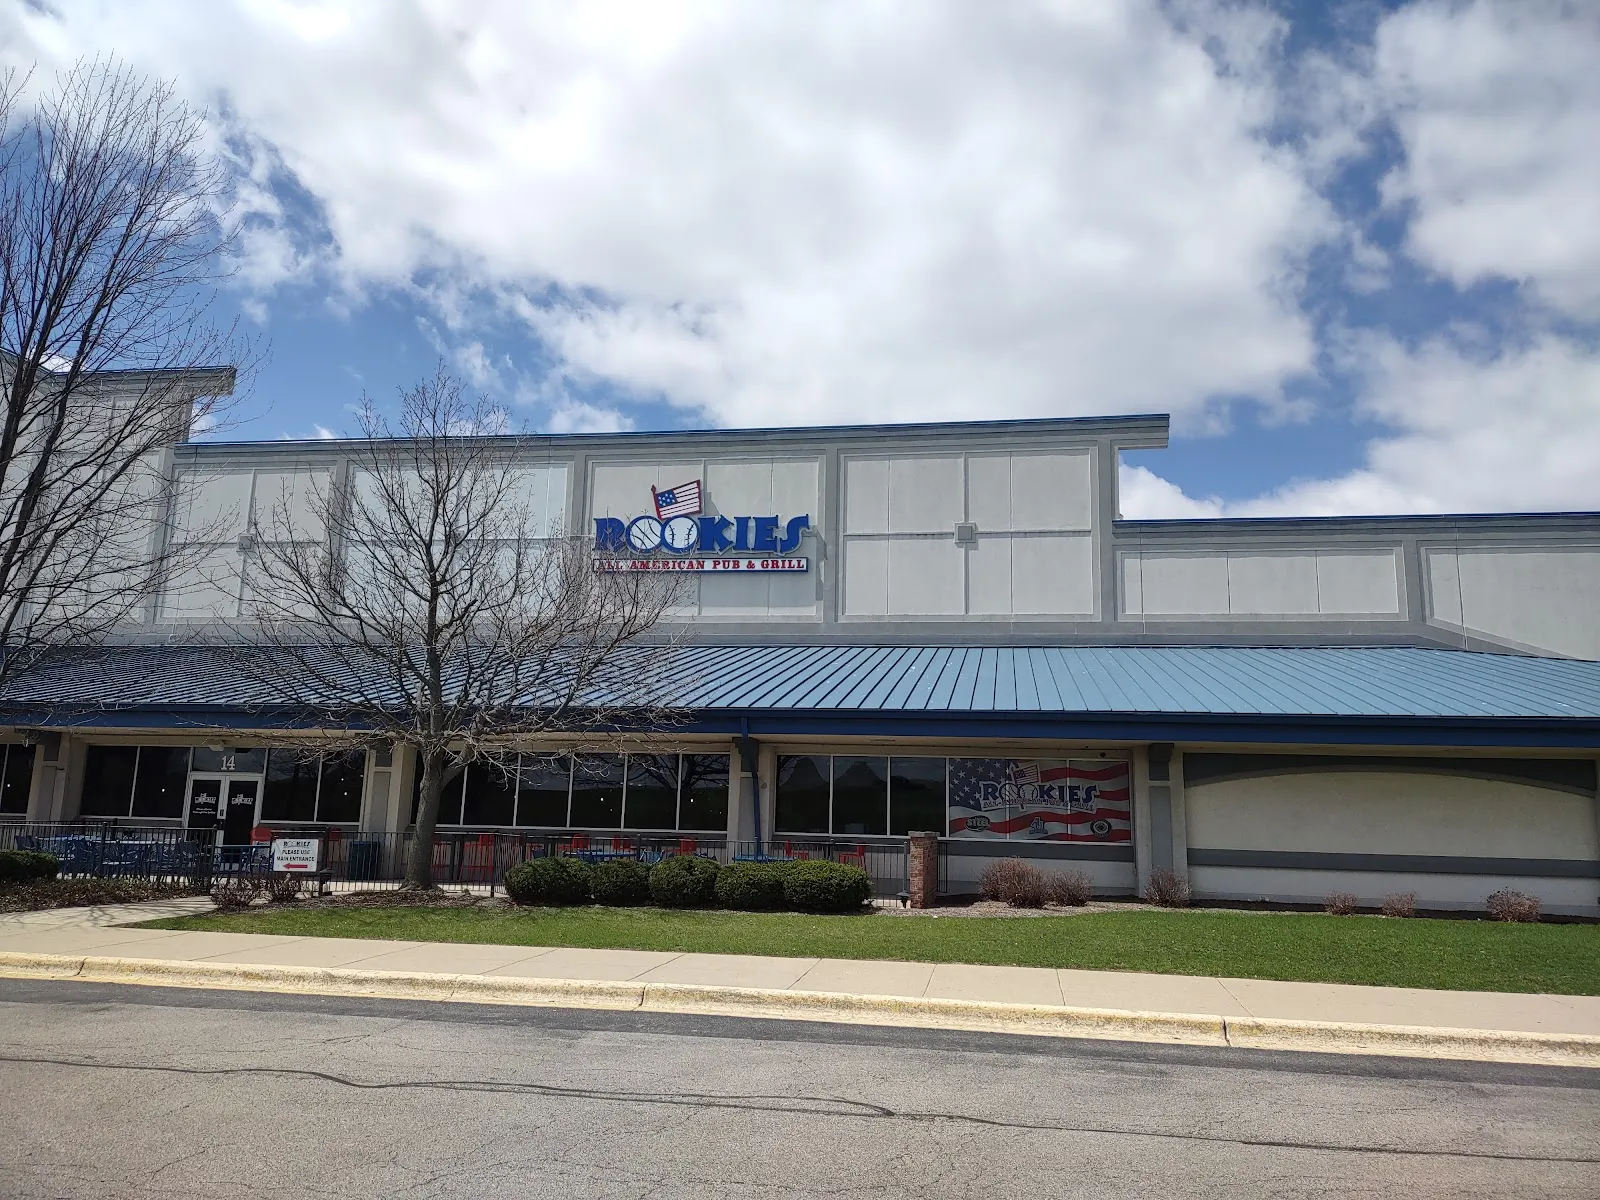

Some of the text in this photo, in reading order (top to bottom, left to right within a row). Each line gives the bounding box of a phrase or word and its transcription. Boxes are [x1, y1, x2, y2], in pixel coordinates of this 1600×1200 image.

[593, 514, 810, 554] ROOKIES
[630, 560, 705, 570] AMERICAN
[712, 560, 741, 570] PUB
[746, 560, 756, 569] &
[761, 559, 805, 569] GRILL
[220, 755, 236, 771] 14
[982, 782, 1097, 802] ROOKIES
